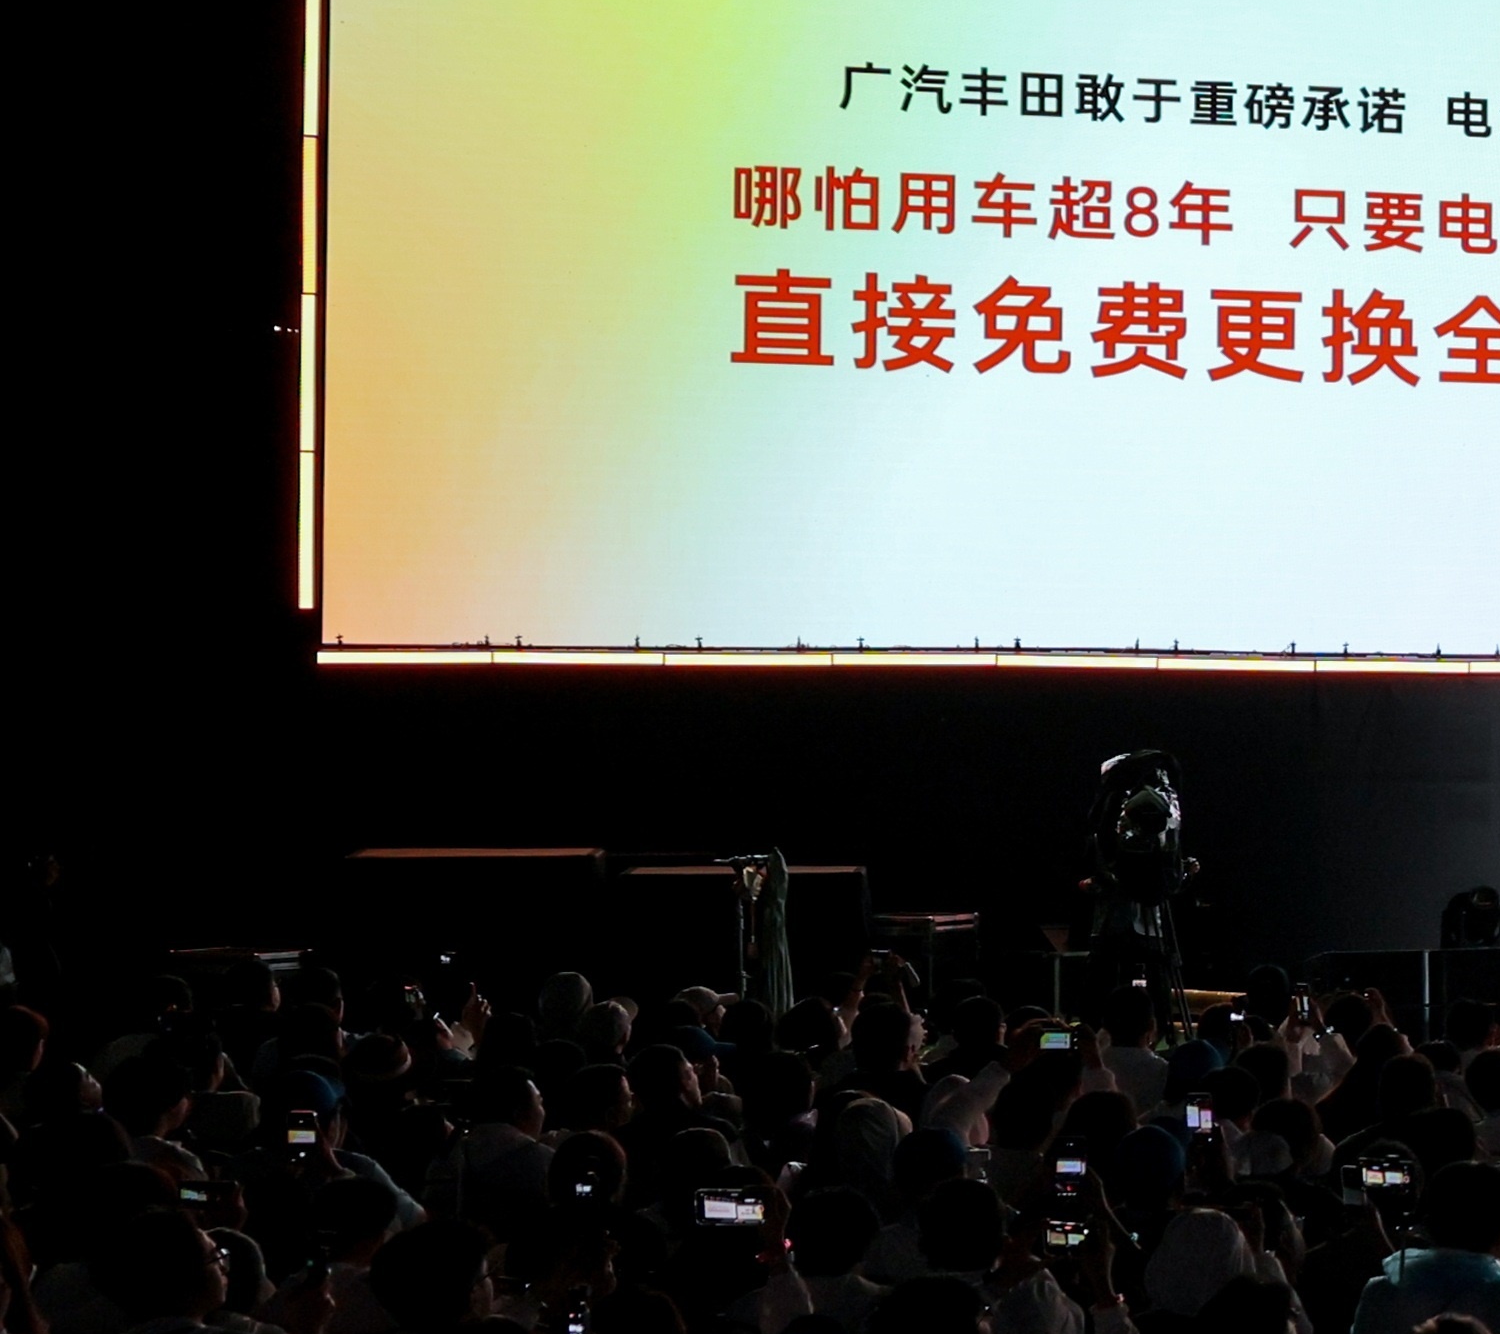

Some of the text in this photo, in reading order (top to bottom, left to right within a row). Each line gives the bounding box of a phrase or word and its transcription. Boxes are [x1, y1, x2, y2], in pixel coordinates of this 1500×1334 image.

[840, 62, 1407, 134] 广汽丰田敢于重磅承诺
[734, 166, 1233, 247] 哪怕用车超8年
